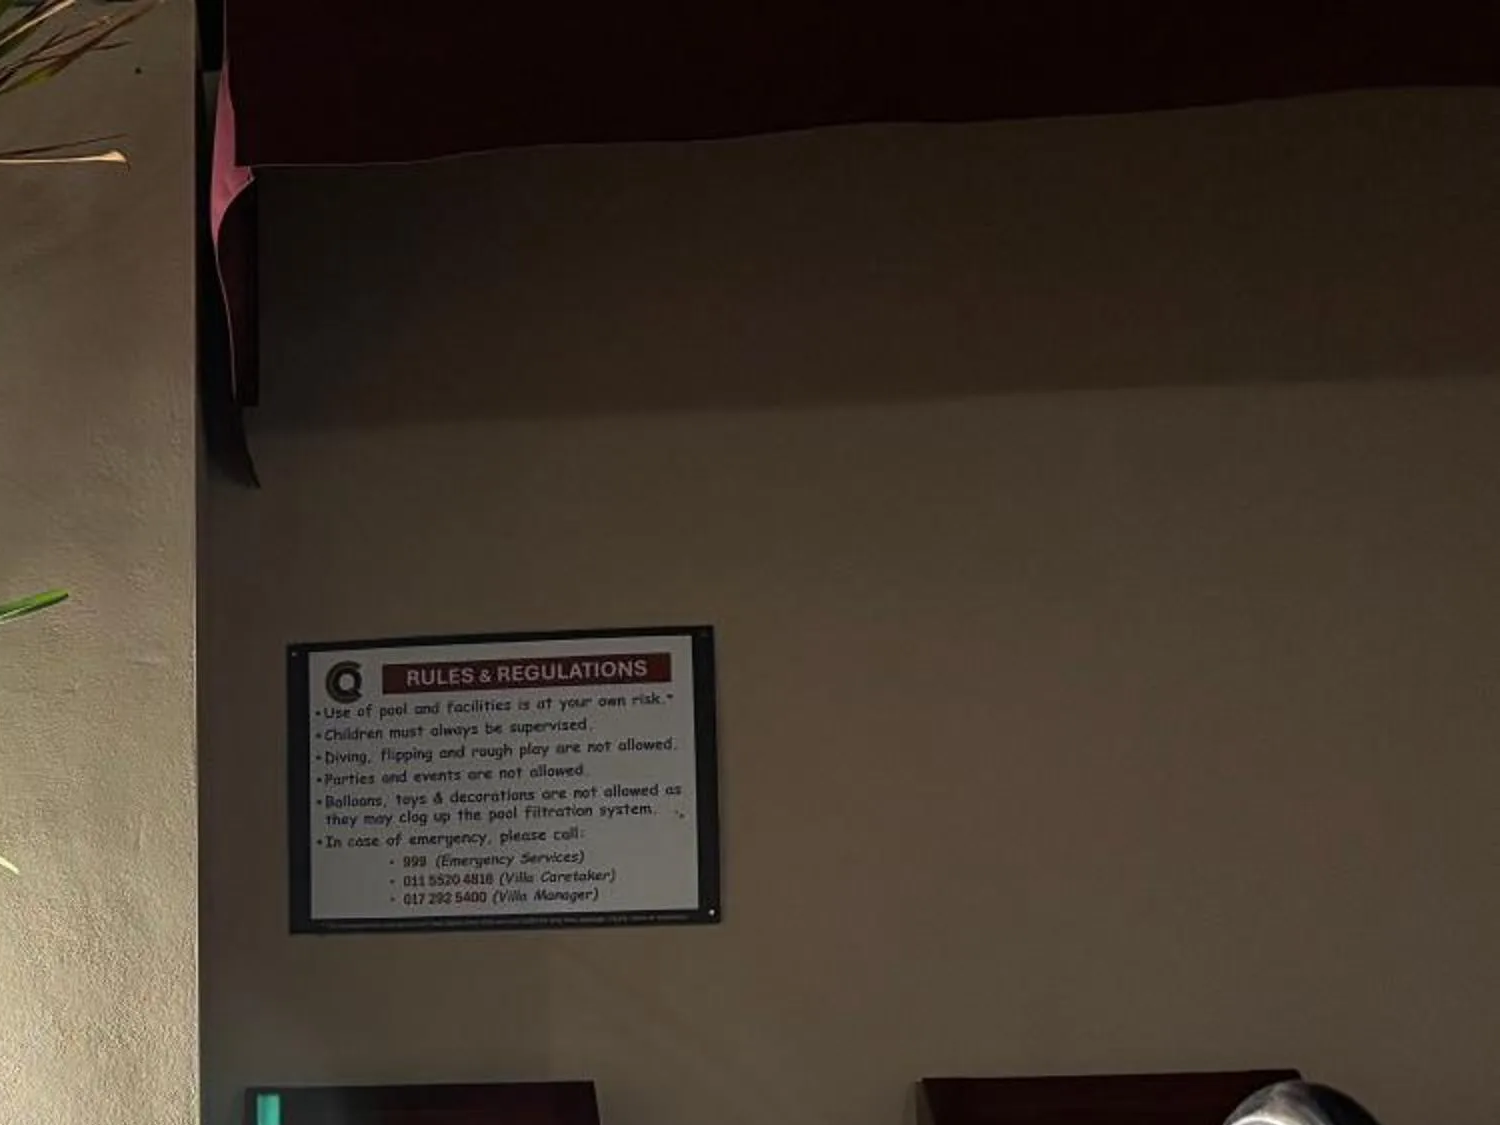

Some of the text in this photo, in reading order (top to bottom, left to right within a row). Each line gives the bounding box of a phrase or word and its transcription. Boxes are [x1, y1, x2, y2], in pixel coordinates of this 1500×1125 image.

[407, 659, 648, 687] RULES & REGULATIONS
[324, 706, 350, 719] Use
[357, 703, 373, 717] of
[379, 703, 407, 720] pool
[414, 701, 439, 715] and
[447, 699, 512, 714] facilities
[518, 698, 530, 711] is
[537, 697, 553, 710] at
[559, 697, 591, 711] your
[597, 696, 627, 707] own
[324, 718, 593, 741] Children must always be supervised.
[325, 737, 677, 764] Diving, flipping and rough play are not allowed.
[325, 773, 374, 785] Parties
[381, 770, 407, 783] and
[414, 770, 461, 783] events
[467, 769, 492, 780] are
[499, 766, 522, 779] not
[325, 784, 682, 809] Balloons, toys & decorations are not allowed as
[325, 803, 659, 828] they may clog up the pool filtration system.
[325, 826, 585, 849] In case of emergency, please call:
[435, 853, 515, 869] (Emergency
[519, 850, 585, 864] Services)
[499, 871, 534, 886] (Villa
[540, 868, 616, 882] Caretaker)
[492, 889, 527, 905] (Villa
[533, 887, 599, 904] Manager)
